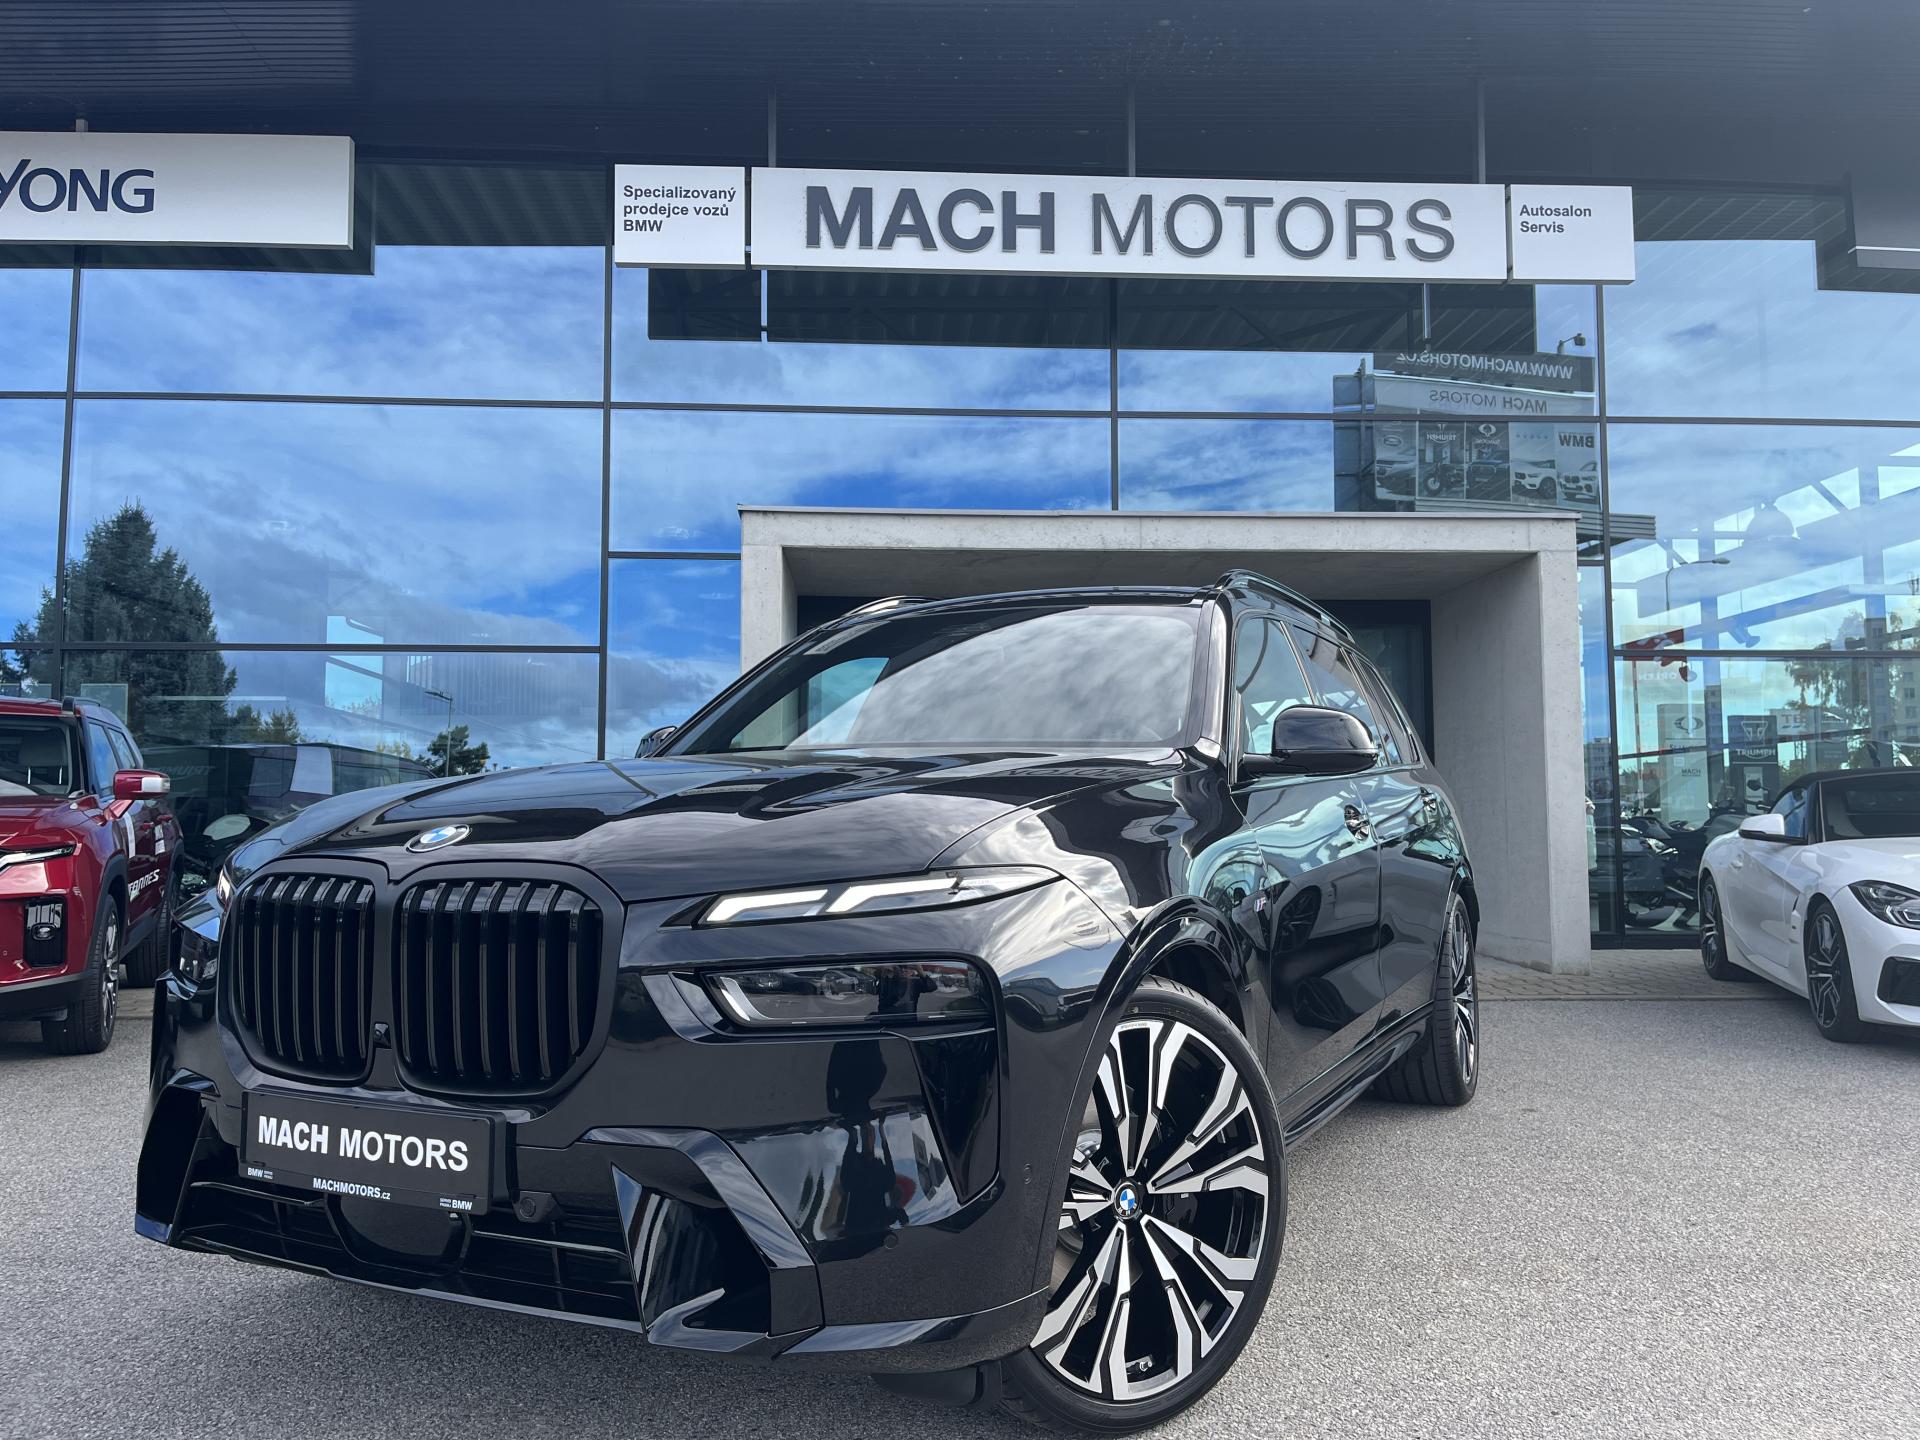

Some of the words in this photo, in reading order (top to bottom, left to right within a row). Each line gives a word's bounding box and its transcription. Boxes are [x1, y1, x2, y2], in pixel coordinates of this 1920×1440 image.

[623, 184, 736, 202] Specializovaný
[623, 203, 689, 218] prodejce
[693, 204, 729, 217] vozů
[1519, 204, 1592, 217] Autosalon
[623, 219, 663, 232] BMW
[806, 185, 1055, 254] MACH
[1092, 192, 1455, 262] MOTORS
[1520, 220, 1565, 233] Servis
[258, 1115, 329, 1154] MACH
[339, 1127, 468, 1172] MOTORS
[247, 1167, 264, 1179] BMW
[312, 1177, 391, 1200] MACHMOTORS.cz
[452, 1199, 473, 1211] BMW
